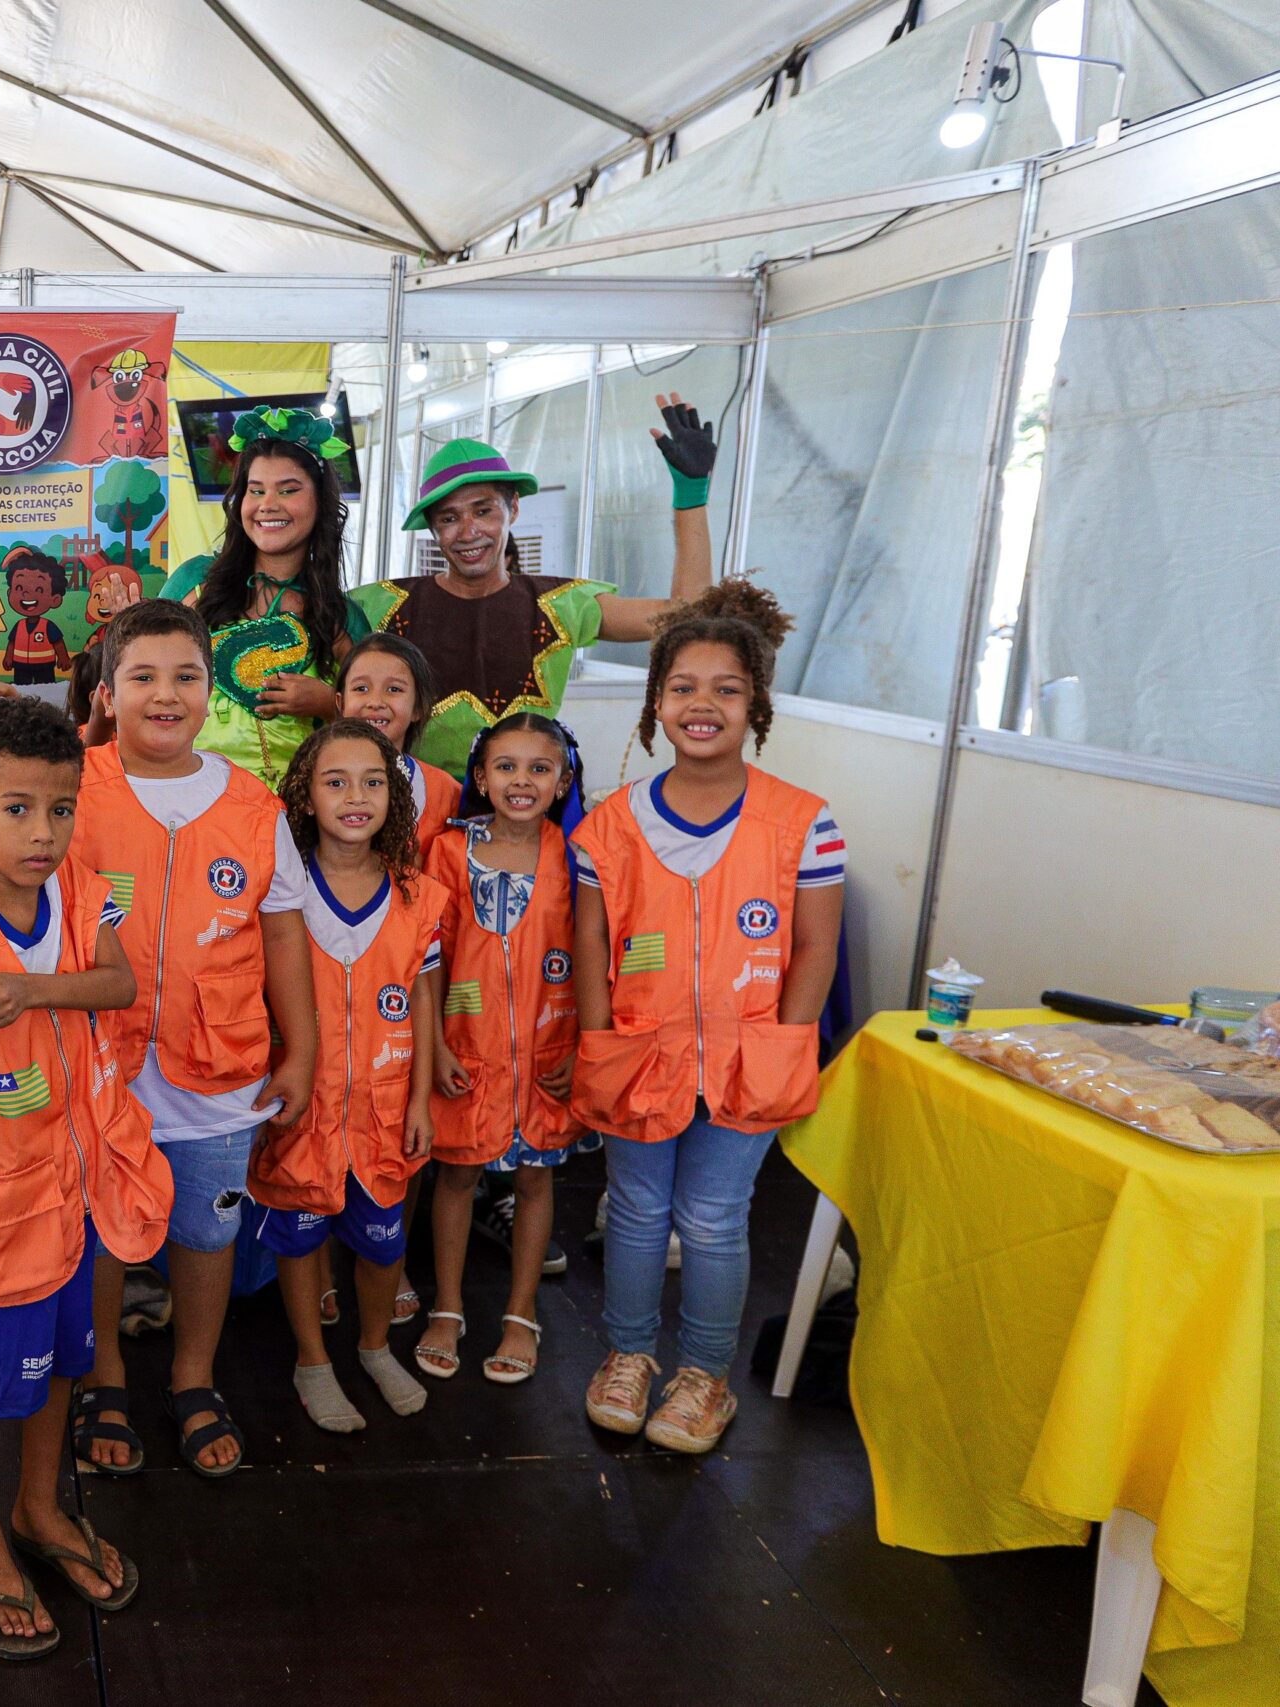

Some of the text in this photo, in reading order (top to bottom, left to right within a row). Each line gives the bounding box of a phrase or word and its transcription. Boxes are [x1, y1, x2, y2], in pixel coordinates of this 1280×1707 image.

[23, 347, 64, 400] CIVIL
[13, 486, 21, 495] A
[23, 481, 83, 496] PROTEÇÃO
[15, 498, 73, 510] CRIANÇAS
[210, 860, 245, 879] DEFESA CIVIL
[753, 969, 780, 979] PIAU
[22, 1350, 54, 1369] SEMEC
